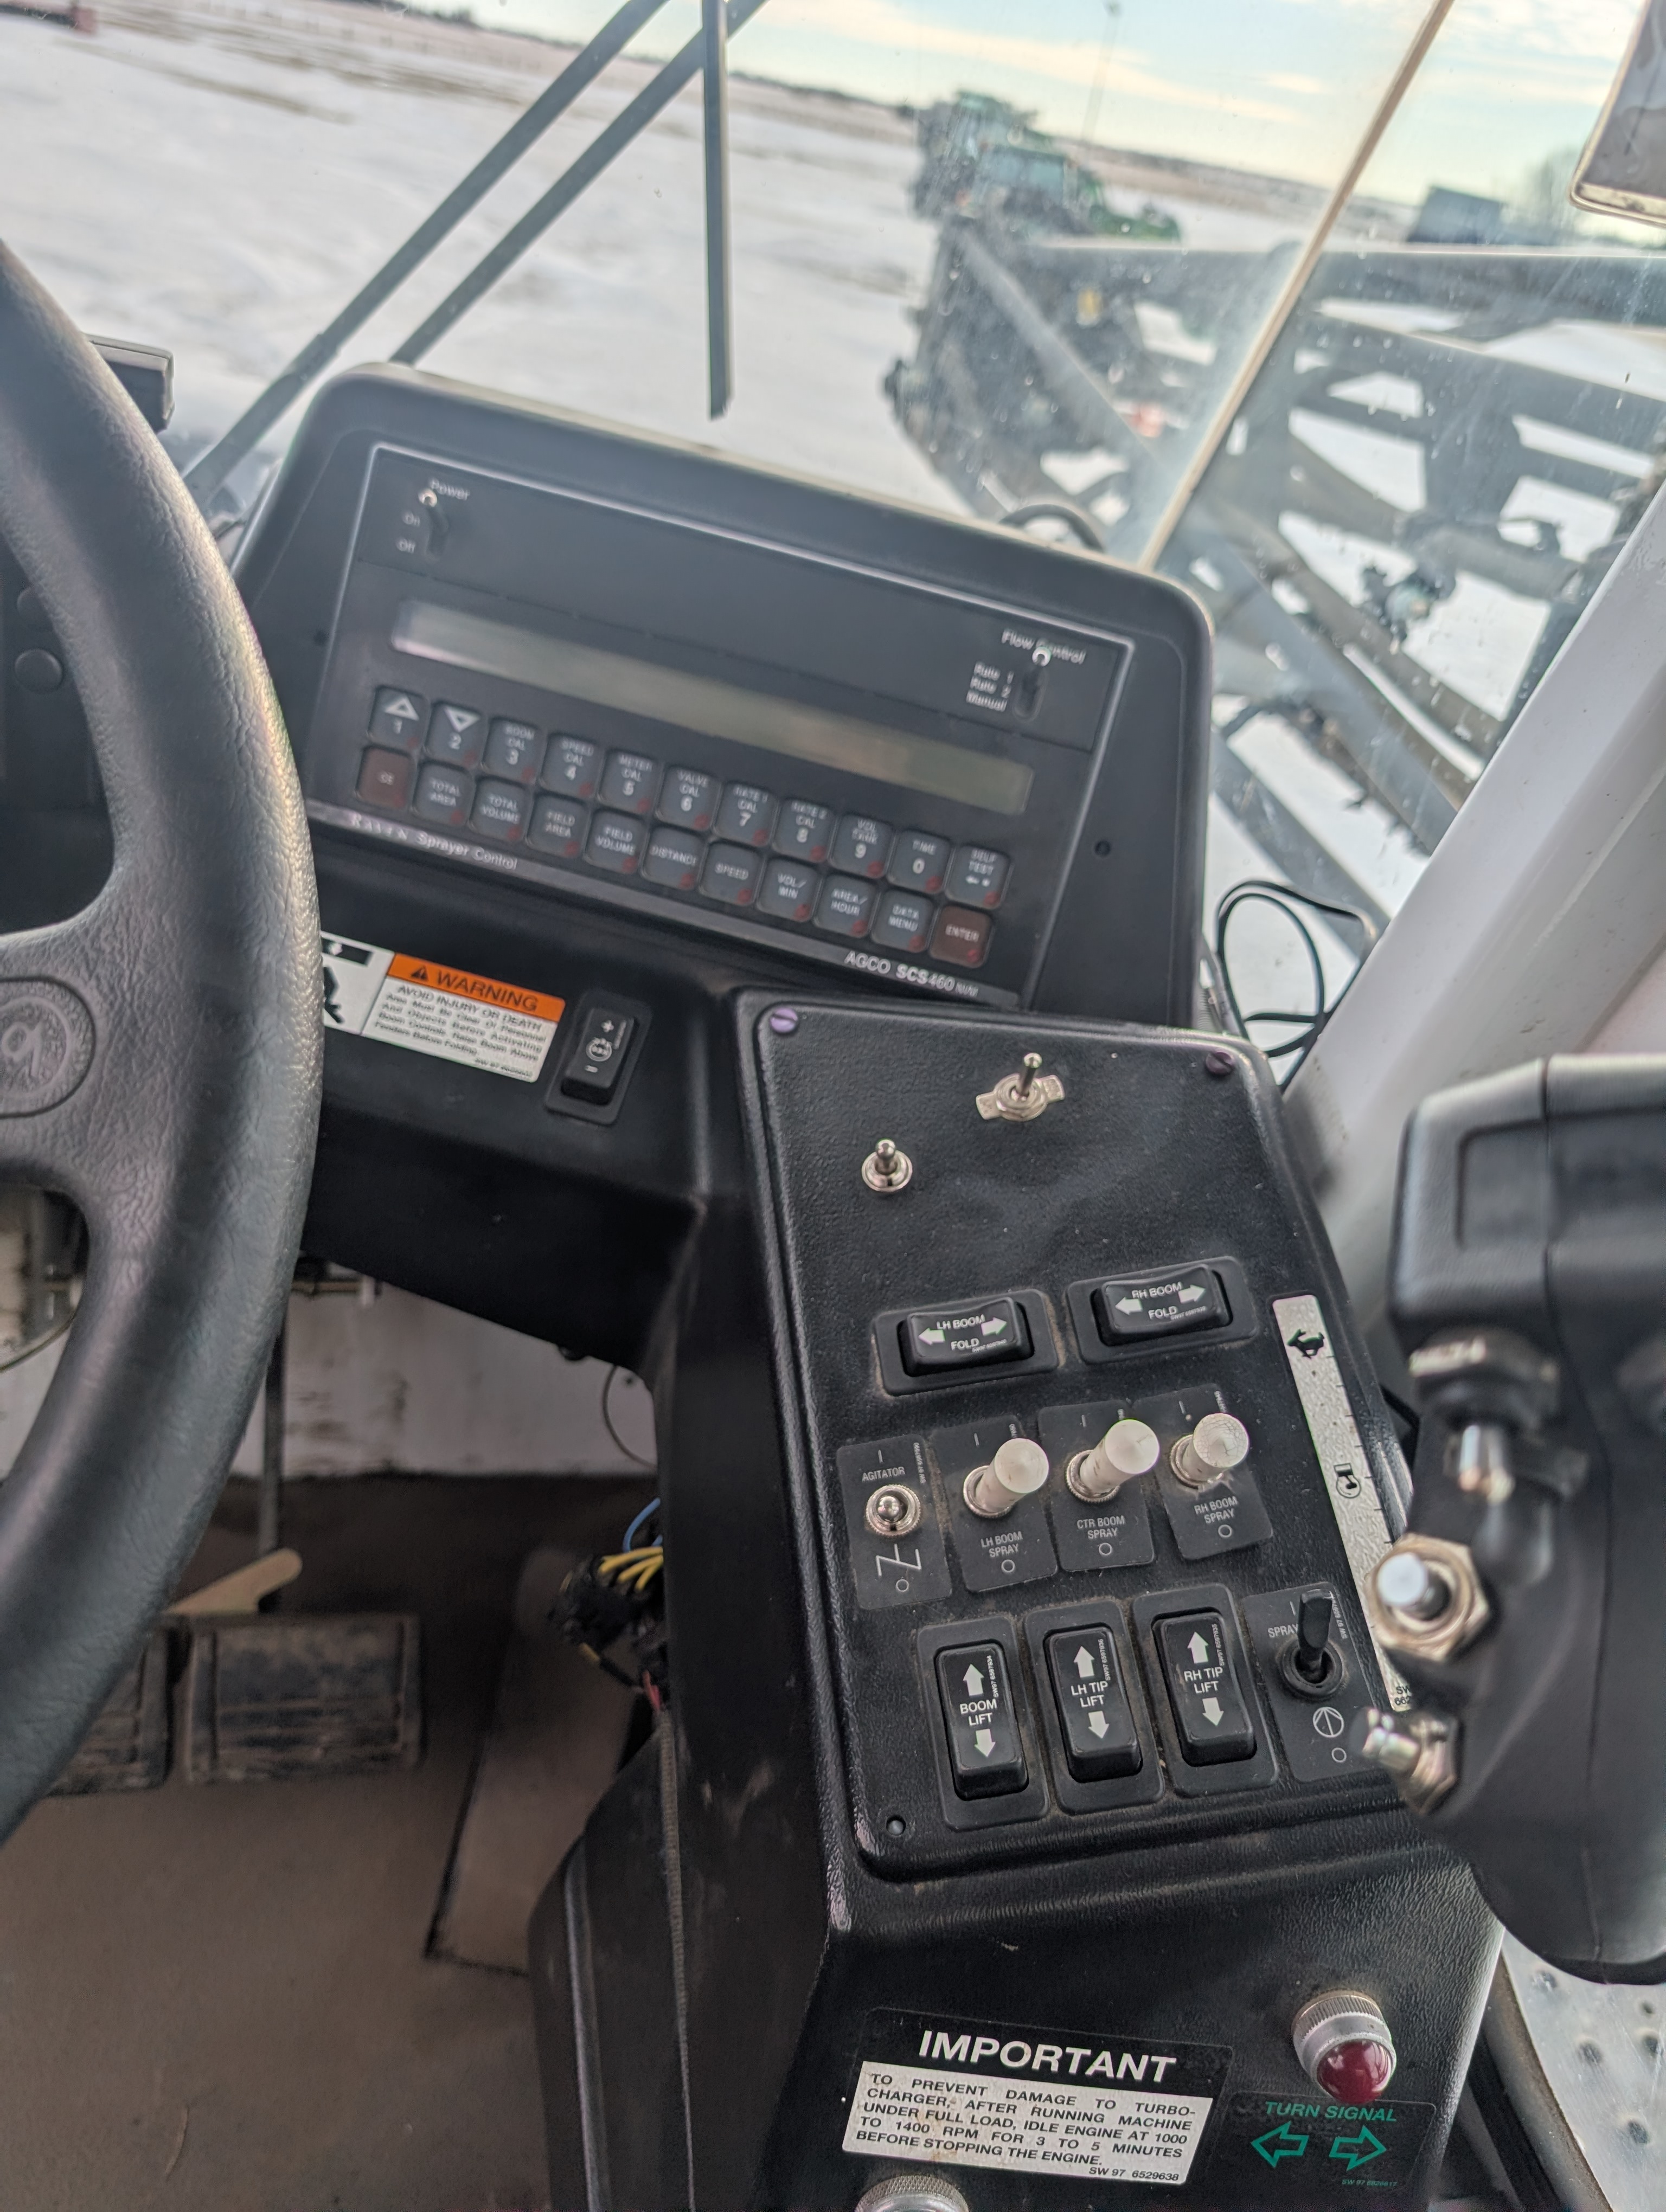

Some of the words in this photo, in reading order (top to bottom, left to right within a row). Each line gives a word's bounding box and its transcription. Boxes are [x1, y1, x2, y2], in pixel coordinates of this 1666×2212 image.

[430, 479, 470, 501] Power
[402, 511, 421, 526] On
[396, 538, 416, 554] Off
[1001, 628, 1036, 650] Flow
[1035, 638, 1087, 665] Cntrol
[393, 719, 402, 734] 1
[450, 734, 462, 750] 2
[507, 737, 526, 751] CAL
[561, 739, 594, 756] SPEED
[507, 750, 519, 765] 3
[565, 753, 584, 766] CAL
[565, 765, 576, 780] 4
[623, 768, 643, 782] CAL
[431, 779, 460, 797] TOTAL
[623, 781, 635, 796] 5
[680, 783, 701, 799] CAL
[430, 791, 457, 807] AREA
[487, 794, 518, 812] TOTAL
[681, 797, 693, 812] 6
[738, 799, 758, 814] CAL
[481, 805, 520, 825] VOLUME
[547, 810, 576, 827] FIELD
[740, 812, 752, 827] 7
[796, 814, 816, 829] CAL
[544, 822, 572, 838] AREA
[603, 826, 633, 842] FIELD
[797, 827, 809, 843] 8
[415, 831, 470, 856] Sprayer
[473, 846, 518, 871] Control
[595, 835, 637, 856] VOLUME
[854, 843, 867, 859] 9
[912, 839, 937, 856] TIME
[714, 863, 749, 880] SPEED
[912, 858, 925, 874] 0
[968, 860, 994, 875] TEST
[776, 873, 807, 888] VOL/
[777, 885, 799, 900] MIN
[832, 888, 868, 904] AREA/
[830, 900, 860, 917] HOUR
[888, 915, 919, 932] MENU
[945, 923, 980, 942] ENTER
[844, 950, 891, 974] AGCO
[437, 969, 537, 1011] WARNING
[398, 985, 434, 1002] AVOID
[437, 994, 479, 1014] INJURY
[482, 1007, 501, 1019] OR
[502, 1013, 542, 1031] DEATH
[407, 1008, 447, 1026] Objects
[452, 1021, 486, 1037] Before
[490, 1031, 543, 1053] Activating
[1131, 1288, 1148, 1300] RH
[1149, 1281, 1182, 1298] BOOM
[1148, 1305, 1177, 1320] FOLD
[936, 1320, 952, 1332] LH
[953, 1314, 986, 1330] BOOM
[950, 1338, 980, 1352] FOLD
[862, 1466, 906, 1483] AGITATOR
[1194, 1503, 1206, 1516] RH
[1207, 1496, 1238, 1513] BOOM
[1077, 1518, 1094, 1530] CTR
[1095, 1515, 1126, 1528] BOOM
[1203, 1509, 1235, 1525] SPRAY
[981, 1535, 992, 1549] LH
[994, 1531, 1023, 1546] BOOM
[1087, 1526, 1119, 1540] SPRAY
[989, 1541, 1020, 1559] SPRAY
[1183, 1669, 1202, 1682] RH
[1203, 1667, 1223, 1679] TIP
[1071, 1684, 1088, 1696] LH
[1088, 1681, 1108, 1693] TIP
[1194, 1681, 1219, 1694] LIFT
[959, 1698, 997, 1715] BOOM
[1079, 1694, 1105, 1708] LIFT
[968, 1712, 993, 1726] LIFT
[919, 2030, 1176, 2083] IMPORTANT
[871, 2074, 893, 2086] TO
[912, 2078, 988, 2097] PREVENT
[1006, 2089, 1077, 2106] DAMAGE
[1095, 2098, 1117, 2110] TO
[1135, 2102, 1196, 2117] TURBO-
[867, 2088, 952, 2108] CHARGER,
[965, 2099, 1018, 2114] AFTER
[1030, 2107, 1105, 2124] RUNNING
[1118, 2116, 1193, 2131] MACHINE
[1265, 2101, 1321, 2117] TURN
[1325, 2105, 1396, 2122] SIGNAL
[863, 2102, 920, 2117] UNDER
[926, 2110, 964, 2124] FULL
[971, 2114, 1017, 2131] LOAD,
[1023, 2120, 1058, 2134] IDLE
[1065, 2125, 1123, 2140] ENGINE
[1127, 2131, 1149, 2142] AT
[1155, 2133, 1188, 2145] 1000
[860, 2116, 882, 2128] TO
[895, 2121, 931, 2134] 1400
[942, 2126, 979, 2139] RPM
[991, 2131, 1023, 2144] FOR
[1035, 2136, 1046, 2146] 3
[1058, 2138, 1079, 2149] TO
[1091, 2141, 1100, 2151] 5
[1112, 2143, 1183, 2158] MINUTES
[856, 2131, 920, 2147] BEFORE
[923, 2138, 1003, 2156] STOPPING
[1007, 2147, 1038, 2160] THE
[1041, 2151, 1103, 2166] ENGINE.
[1088, 2167, 1110, 2177] SW
[1112, 2169, 1126, 2178] 97
[1131, 2170, 1179, 2181] 6529638
